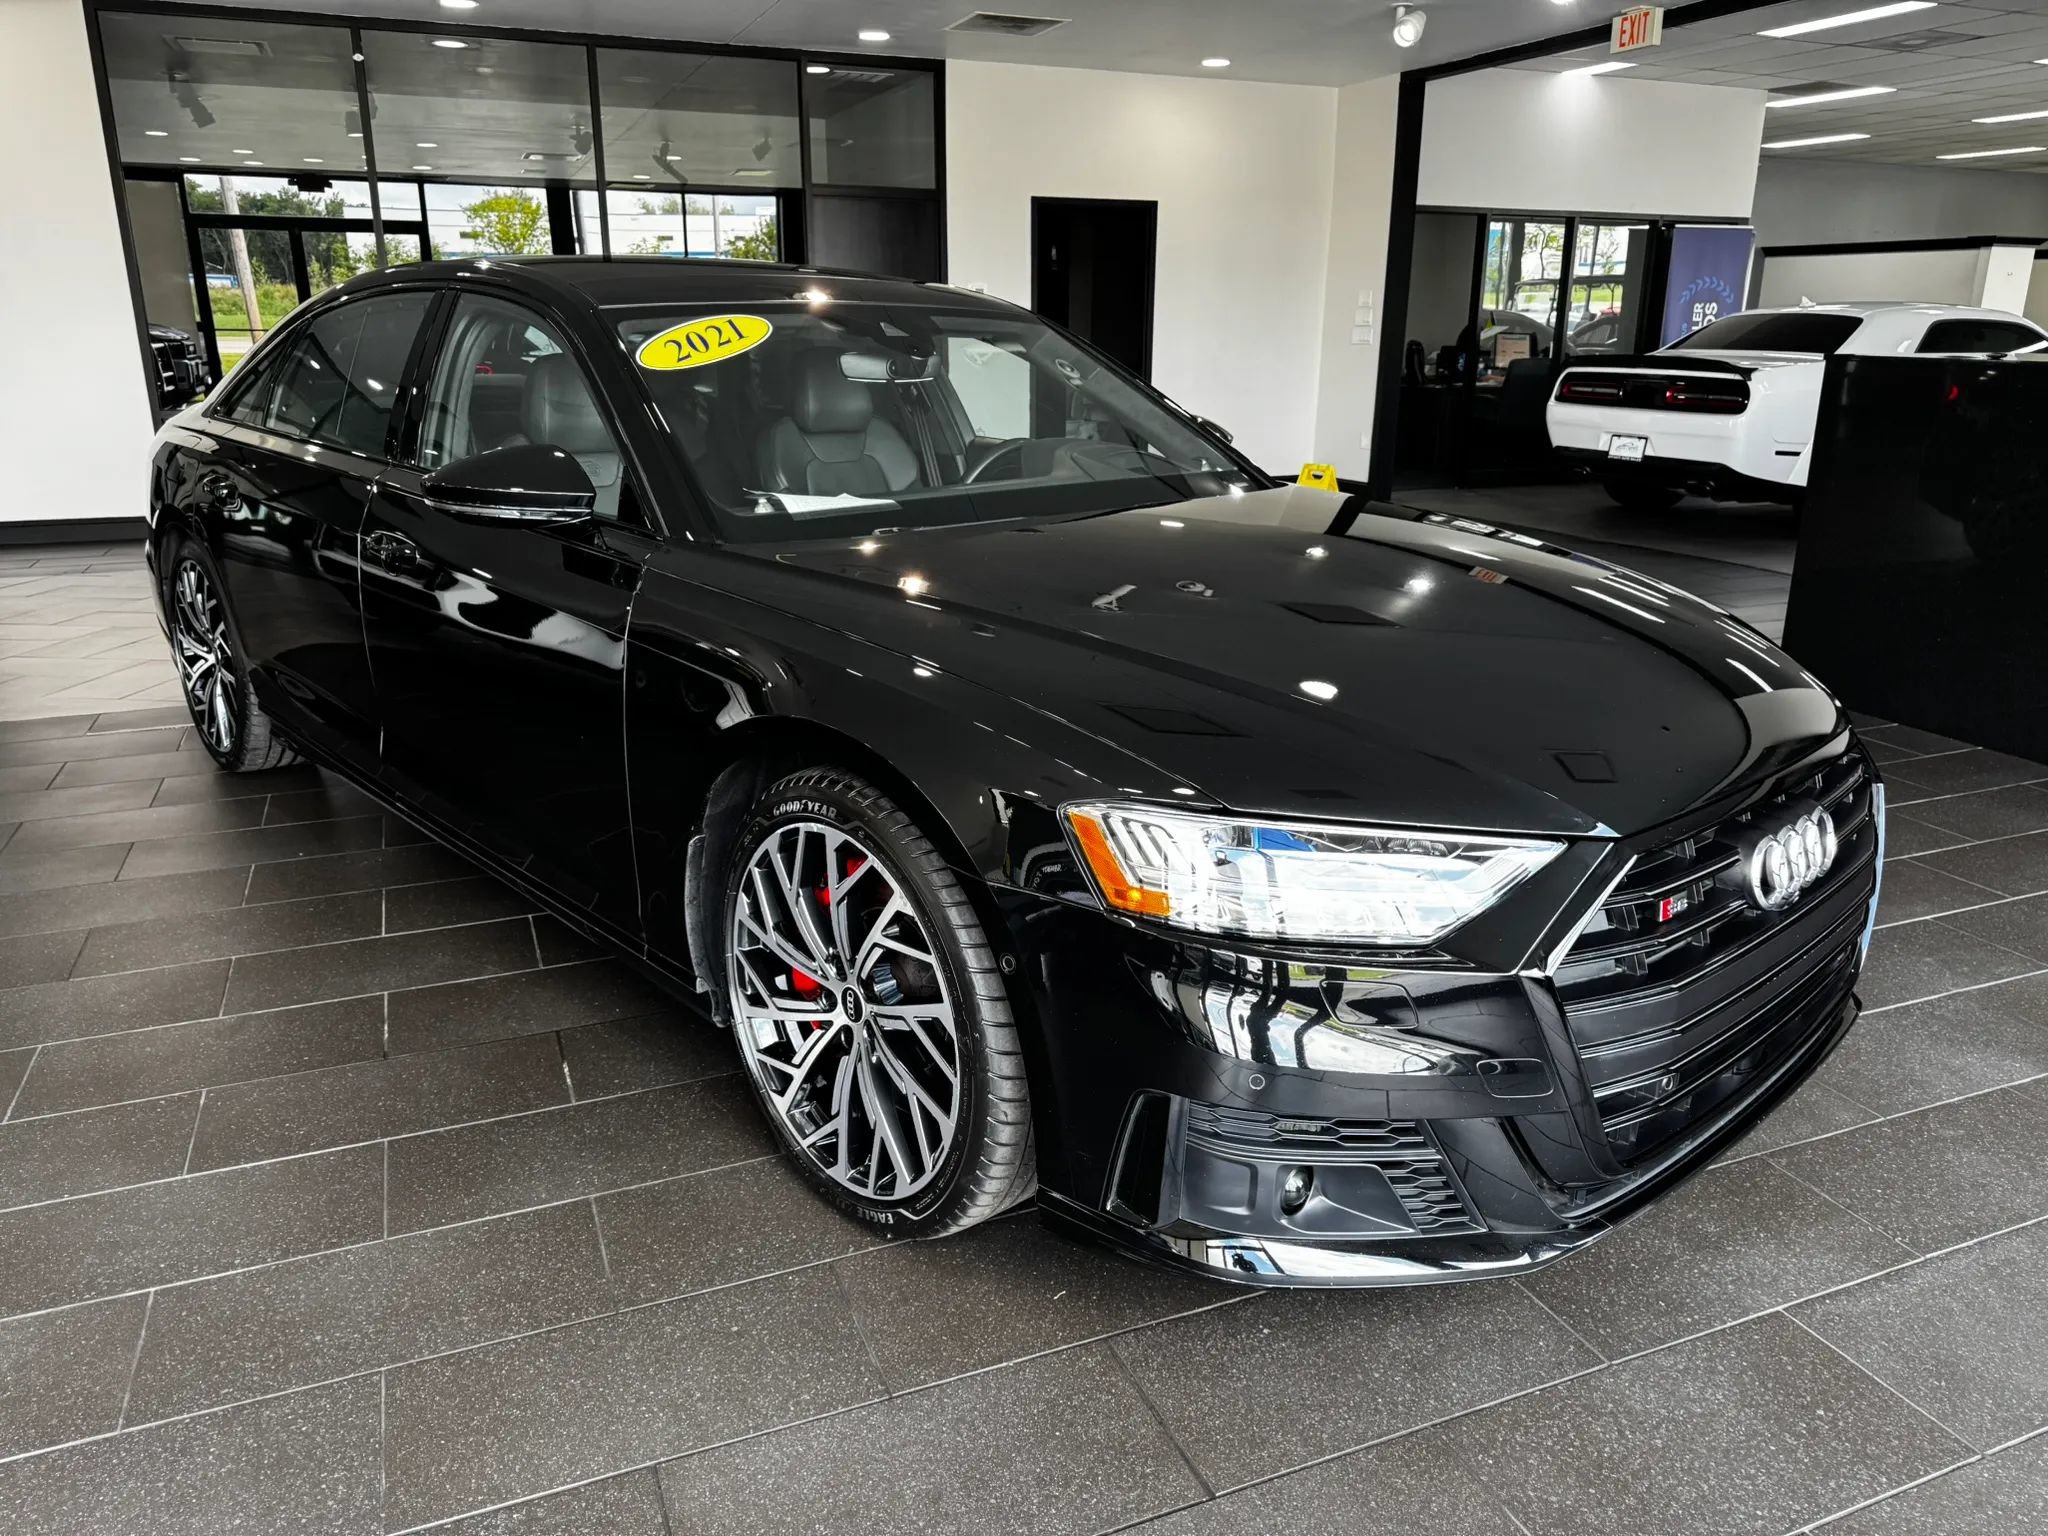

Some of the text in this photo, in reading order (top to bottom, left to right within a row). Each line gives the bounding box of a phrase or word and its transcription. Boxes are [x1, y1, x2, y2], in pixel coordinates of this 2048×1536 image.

[1619, 11, 1650, 48] EXIT
[664, 319, 748, 363] 2021
[773, 800, 837, 819] GOODYEAR
[856, 1206, 894, 1225] EAGLE
